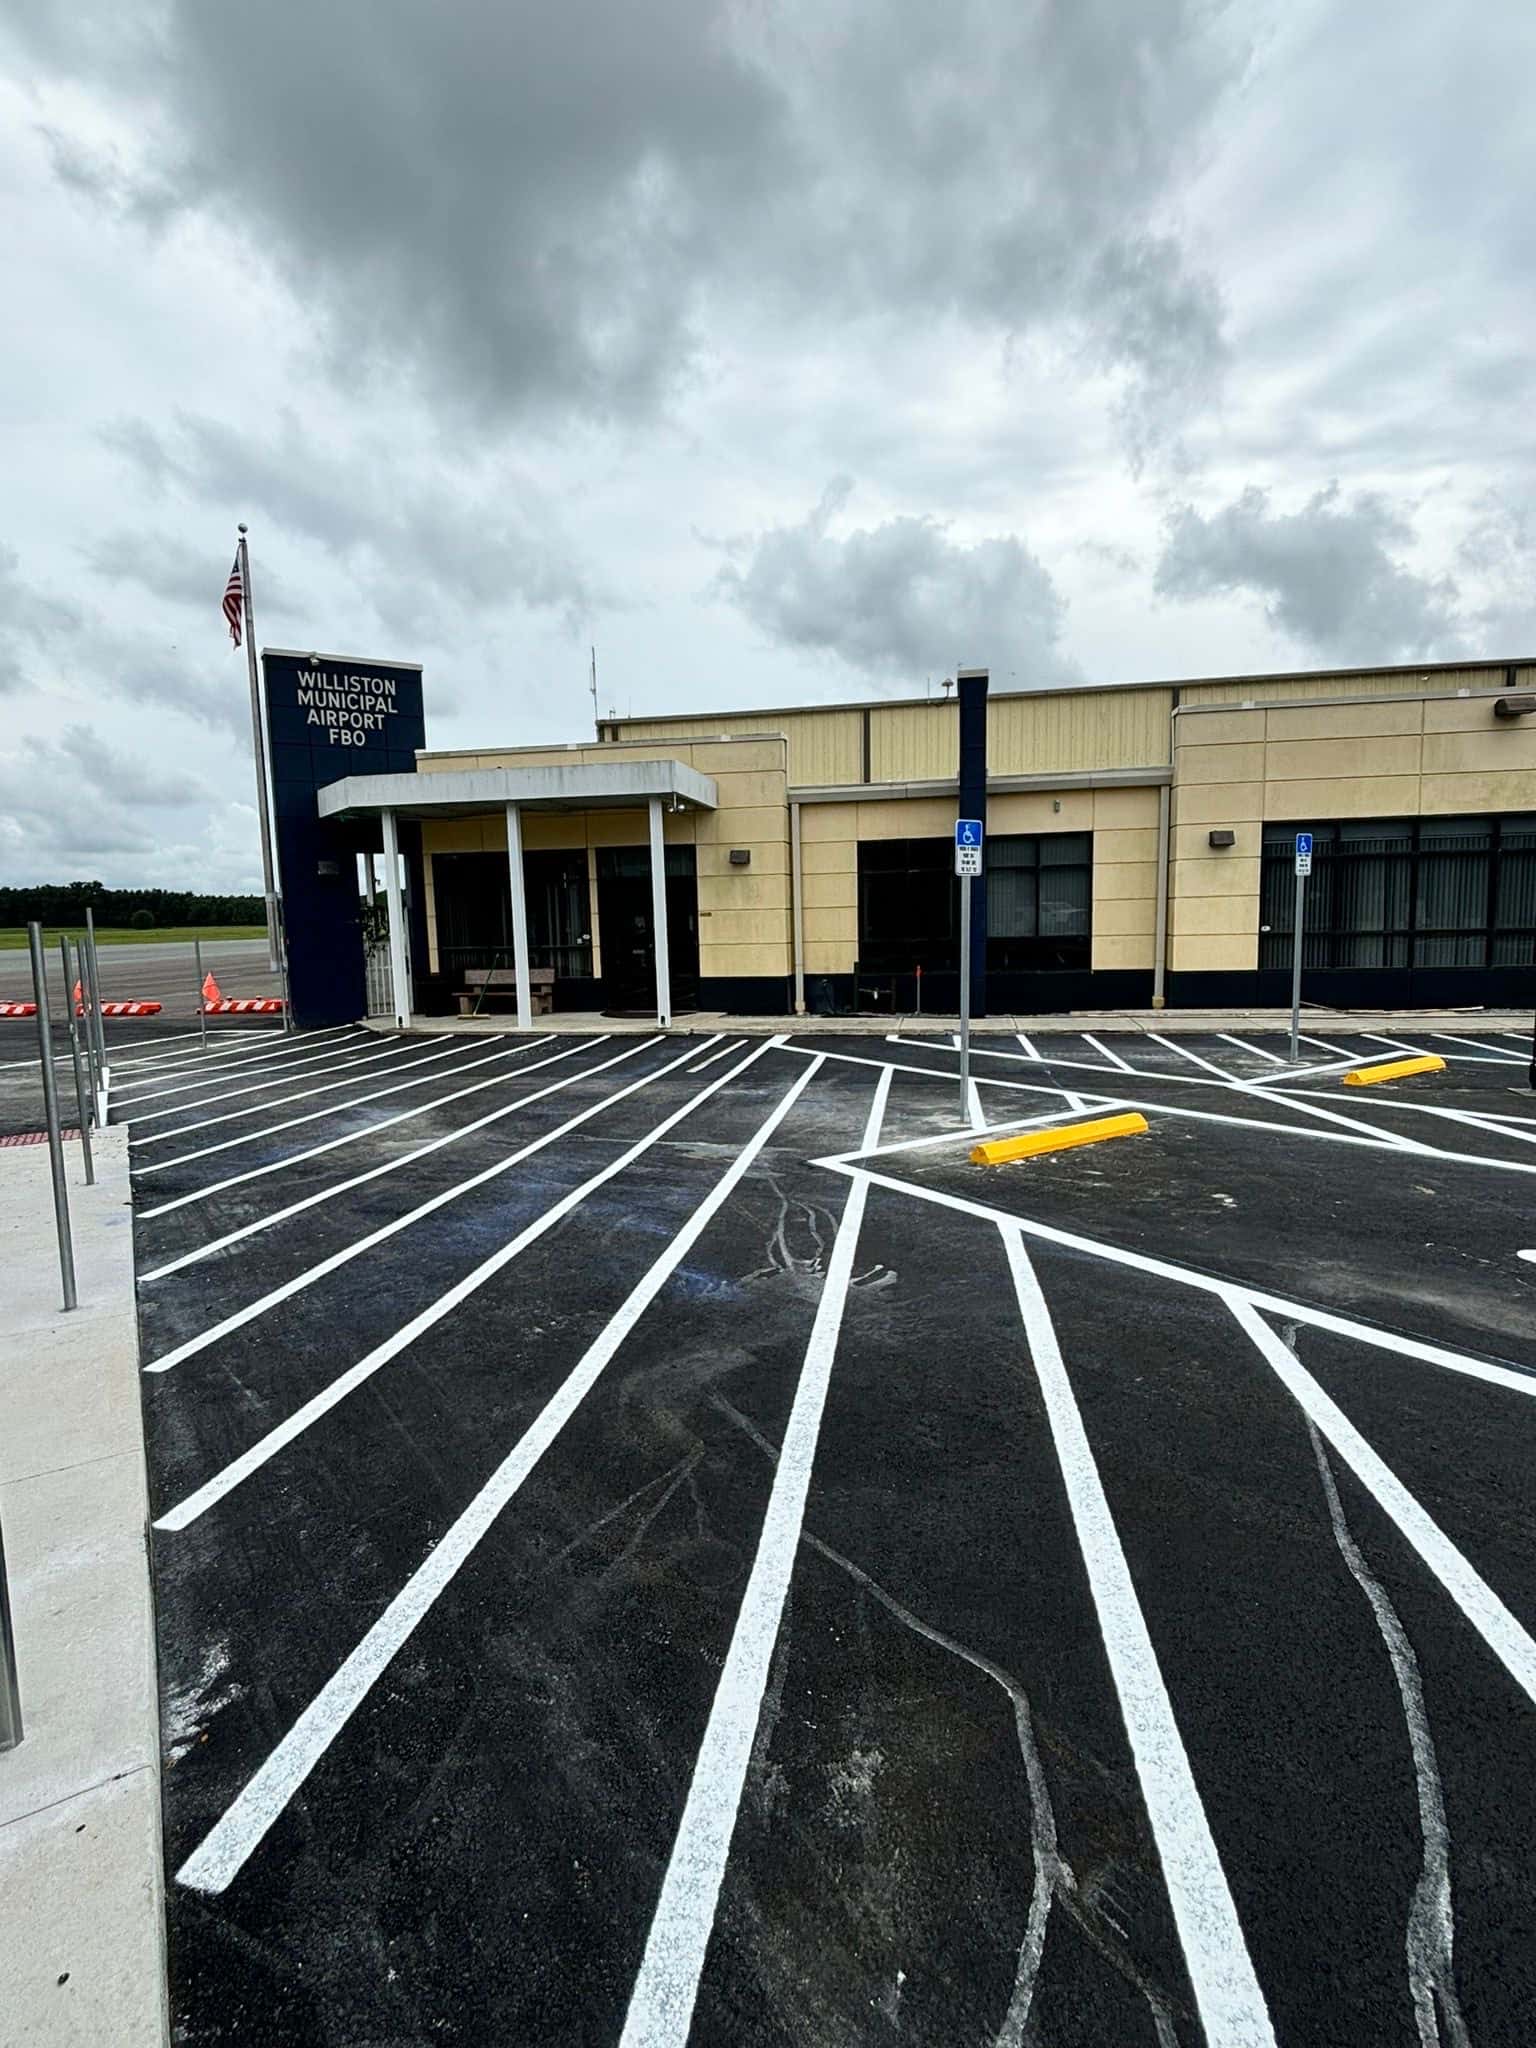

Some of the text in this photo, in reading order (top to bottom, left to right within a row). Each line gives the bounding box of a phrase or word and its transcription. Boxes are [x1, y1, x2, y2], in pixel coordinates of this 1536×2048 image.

[297, 671, 396, 696] WILLISTON
[297, 689, 398, 714] MUNICIPAL
[306, 708, 385, 730] AIRPORT
[329, 728, 366, 747] FBO
